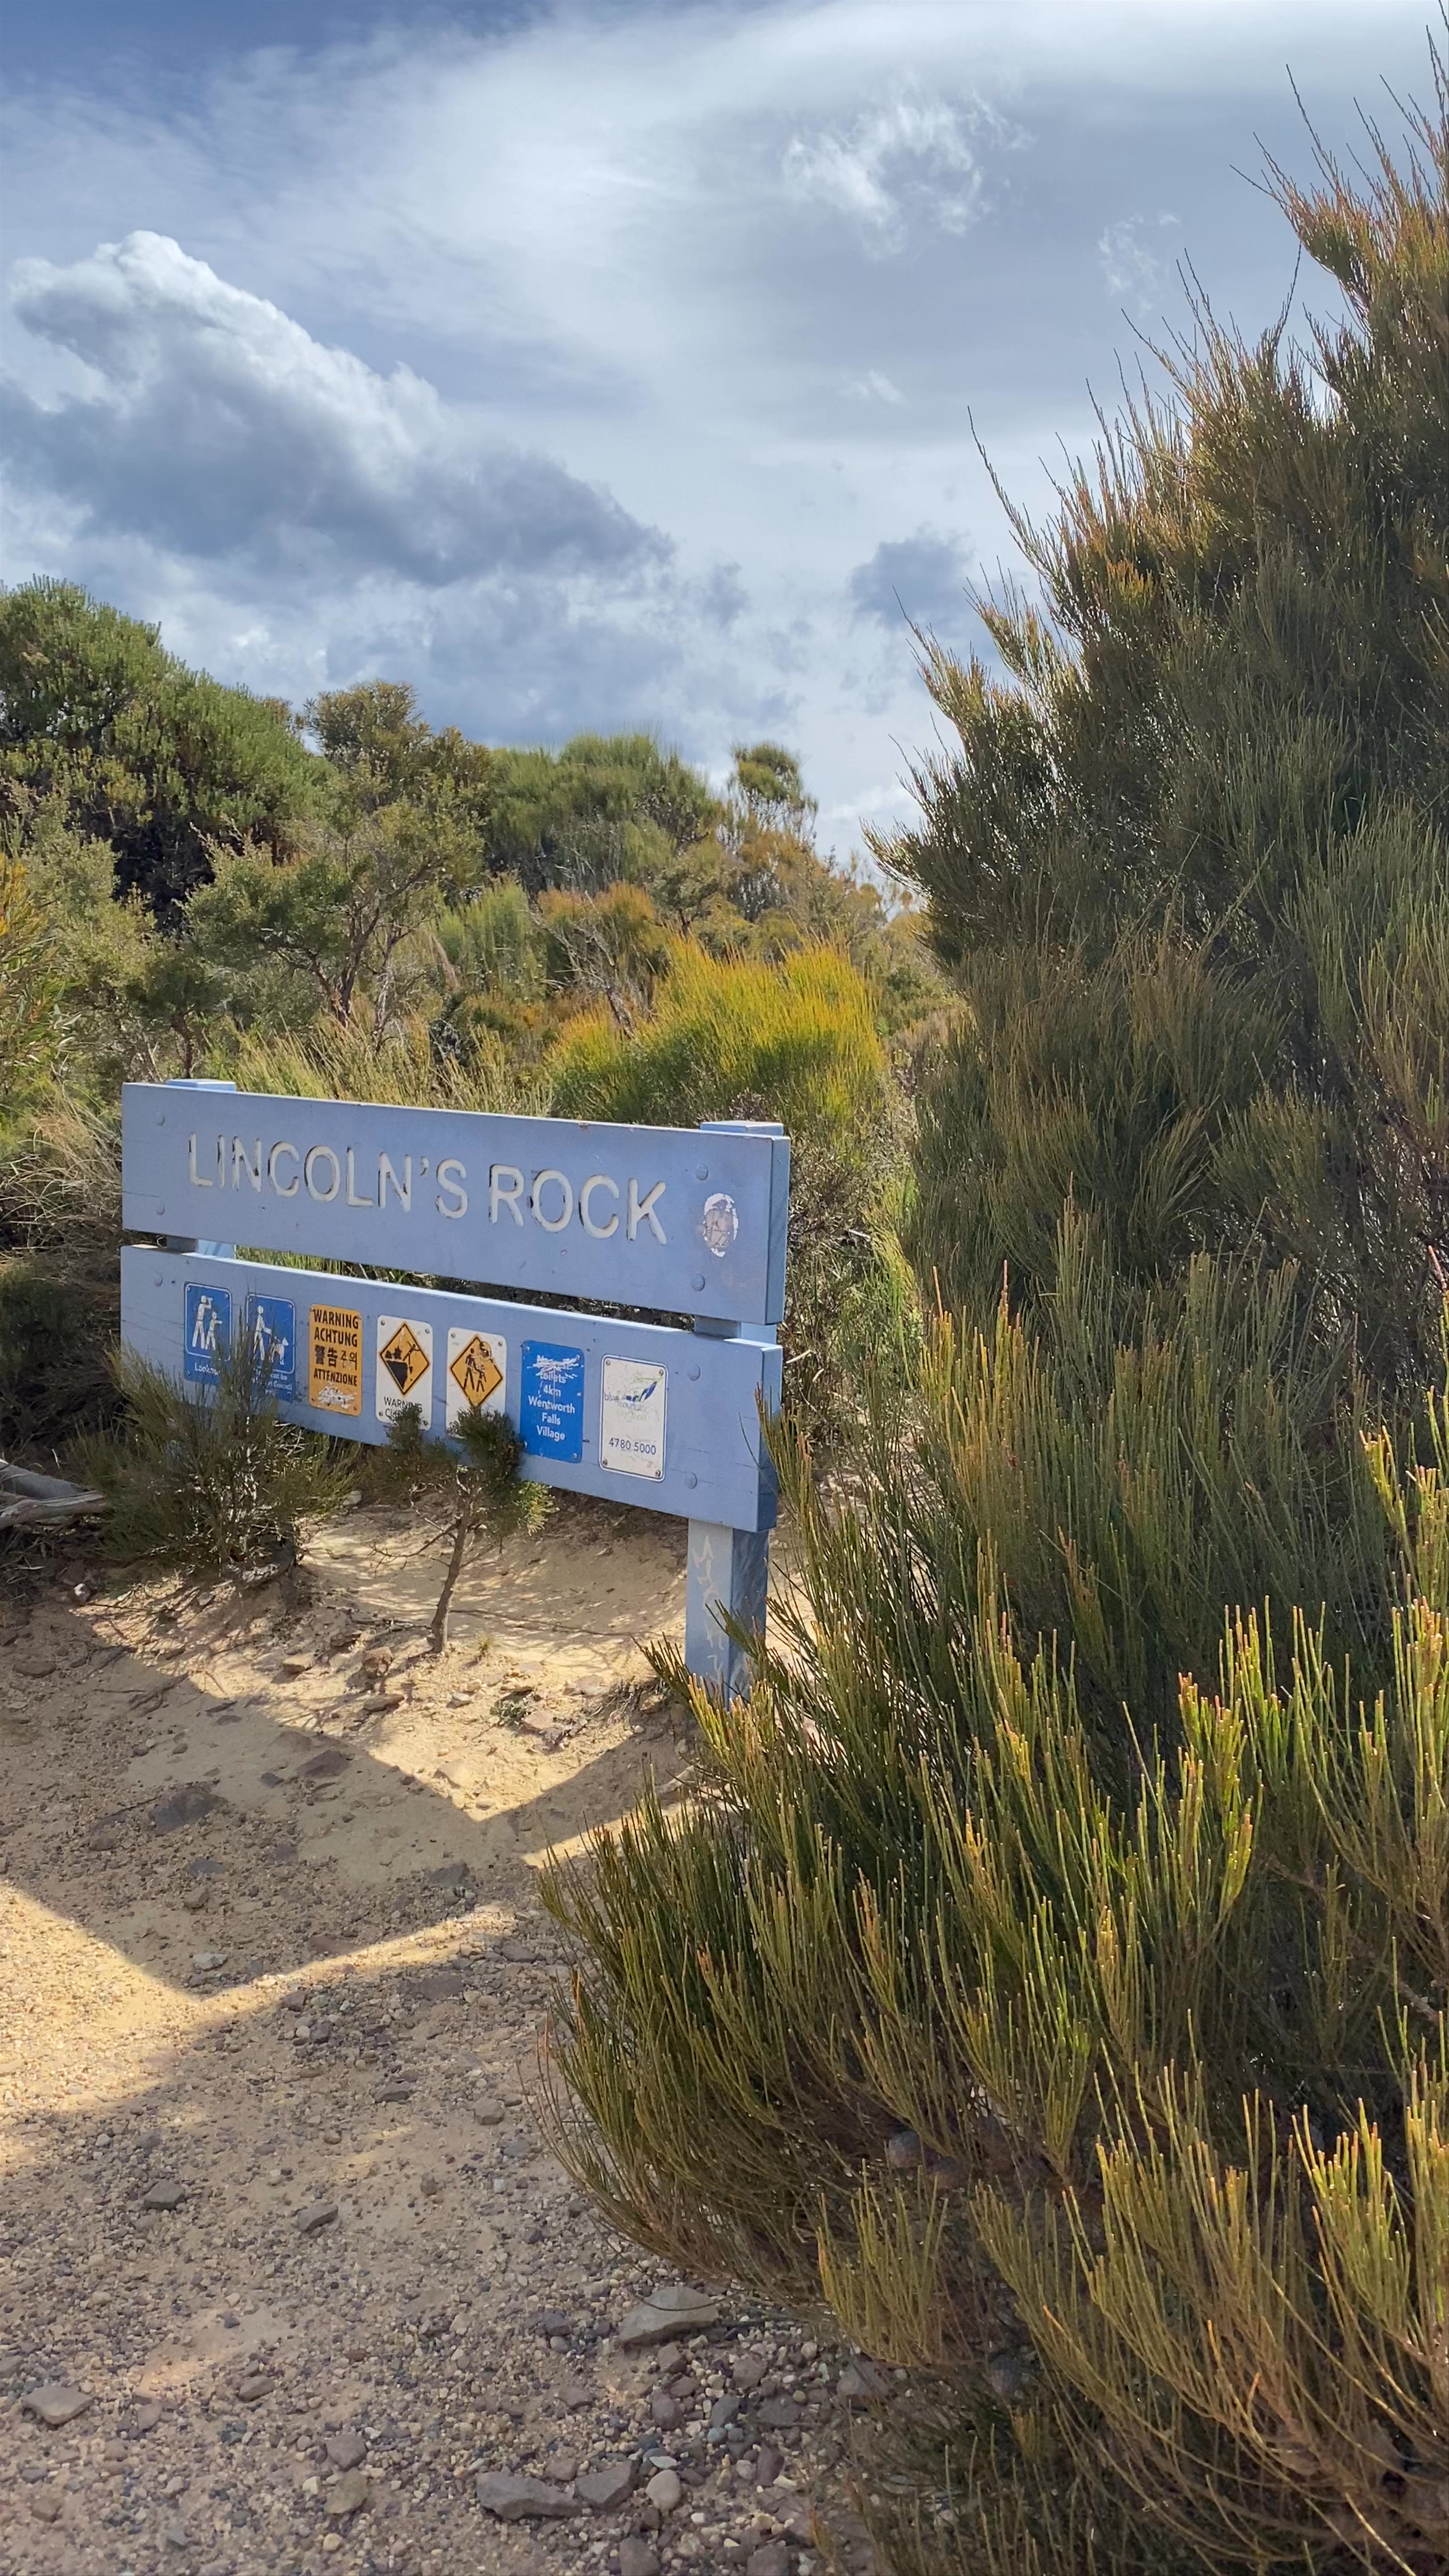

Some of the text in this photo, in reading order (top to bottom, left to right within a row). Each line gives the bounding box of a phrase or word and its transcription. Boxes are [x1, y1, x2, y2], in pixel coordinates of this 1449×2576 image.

[188, 1132, 667, 1245] LINCOLN'S ROCK
[313, 1309, 358, 1329] WARNING
[314, 1327, 358, 1347] ACHTUNG
[314, 1344, 338, 1368] 警告
[314, 1368, 357, 1387] ATTENZIONE
[543, 1385, 561, 1397] 4km
[528, 1395, 575, 1414] Wentworth
[542, 1412, 561, 1425] Falls
[536, 1425, 565, 1442] Village
[609, 1437, 657, 1455] 4780 5000
